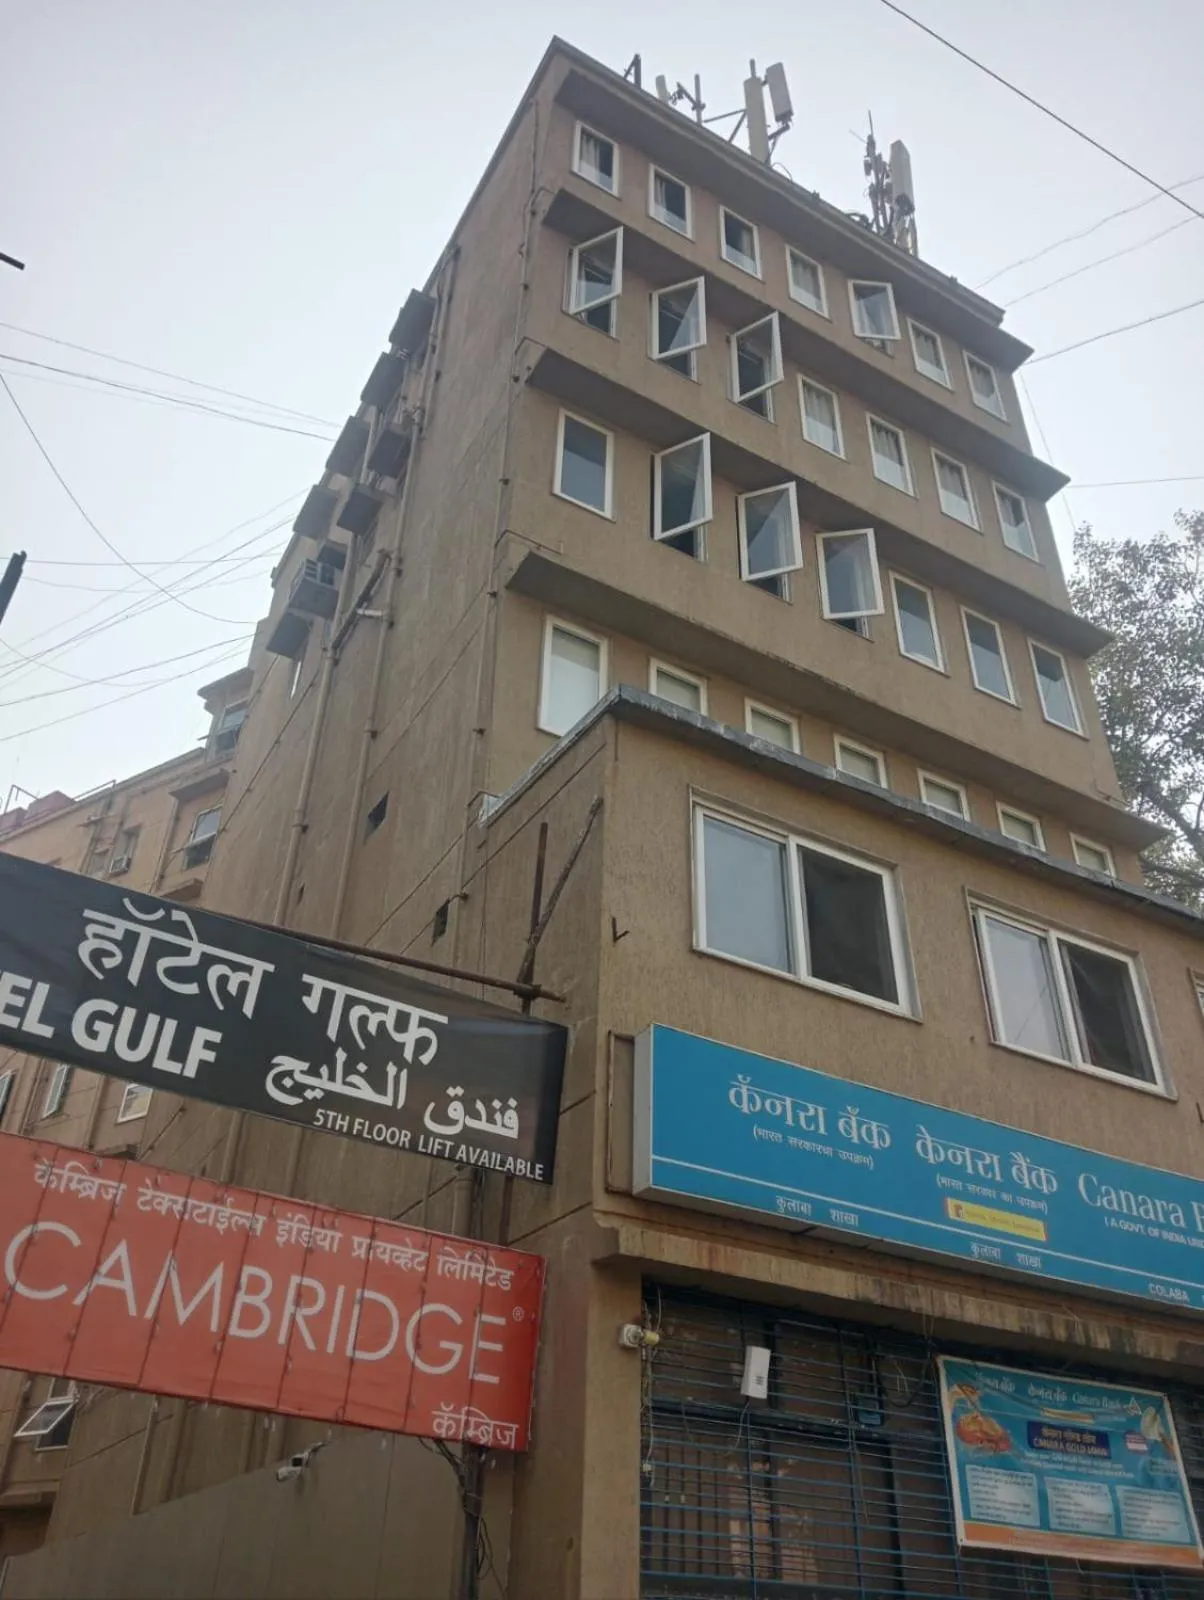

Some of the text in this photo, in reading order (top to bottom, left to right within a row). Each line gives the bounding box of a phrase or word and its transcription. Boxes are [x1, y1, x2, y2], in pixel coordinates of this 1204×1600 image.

[78, 898, 448, 1065] हॉटेल गल्फ
[0, 971, 223, 1079] EL GULF
[265, 1047, 519, 1139] فندق الخليج
[313, 1108, 544, 1181] 5TH FLOOR LIFT AVAILABLE
[915, 1124, 1058, 1194] केनरा बैंक
[275, 1212, 343, 1253] इंडिया
[1078, 1173, 1188, 1229] Canara
[4, 1221, 507, 1385] CAMBRIDGE
[432, 1401, 519, 1450] कॅम्ब्रिज
